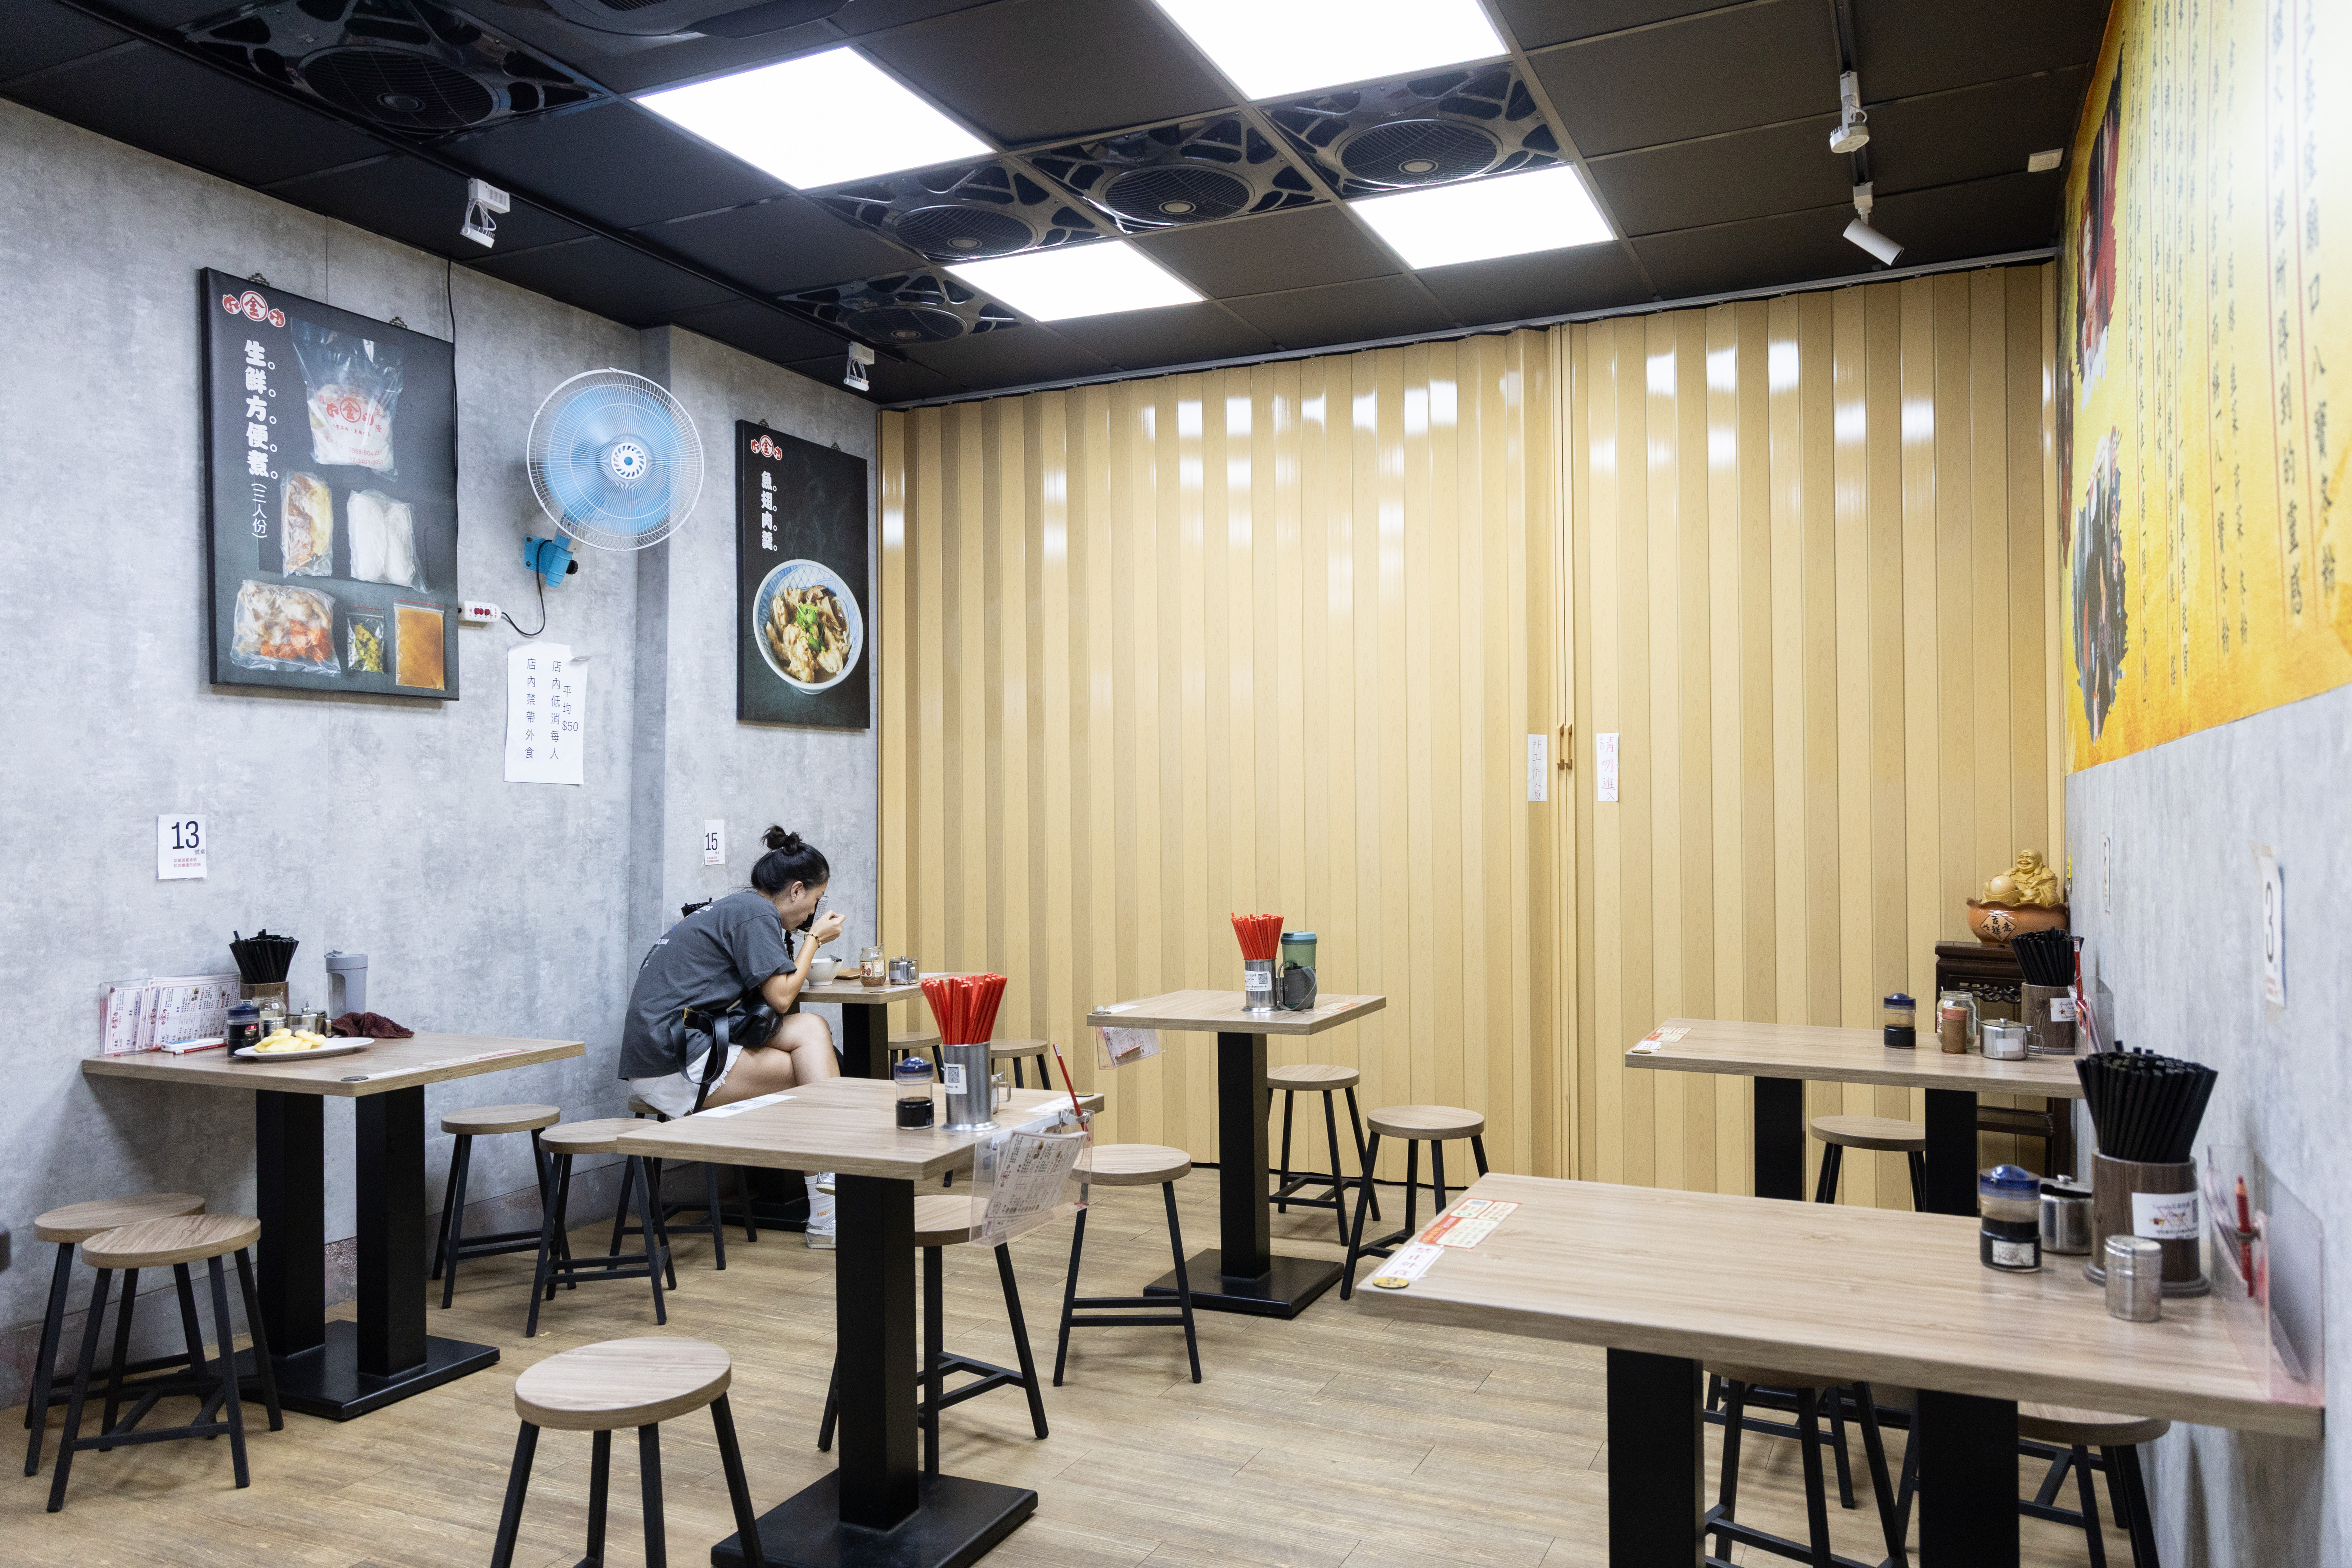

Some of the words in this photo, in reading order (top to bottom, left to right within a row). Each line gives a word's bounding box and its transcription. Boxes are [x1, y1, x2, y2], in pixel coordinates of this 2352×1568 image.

[525, 658, 537, 759] 店內禁帶外食
[550, 660, 561, 760] 店內低消每人
[562, 720, 578, 732] $50
[563, 685, 572, 715] 平均
[1532, 738, 1541, 801] 非工作人員
[1599, 736, 1616, 801] 請勿進入
[171, 821, 199, 850] 13
[705, 832, 718, 850] 15
[2265, 881, 2274, 963] 3
